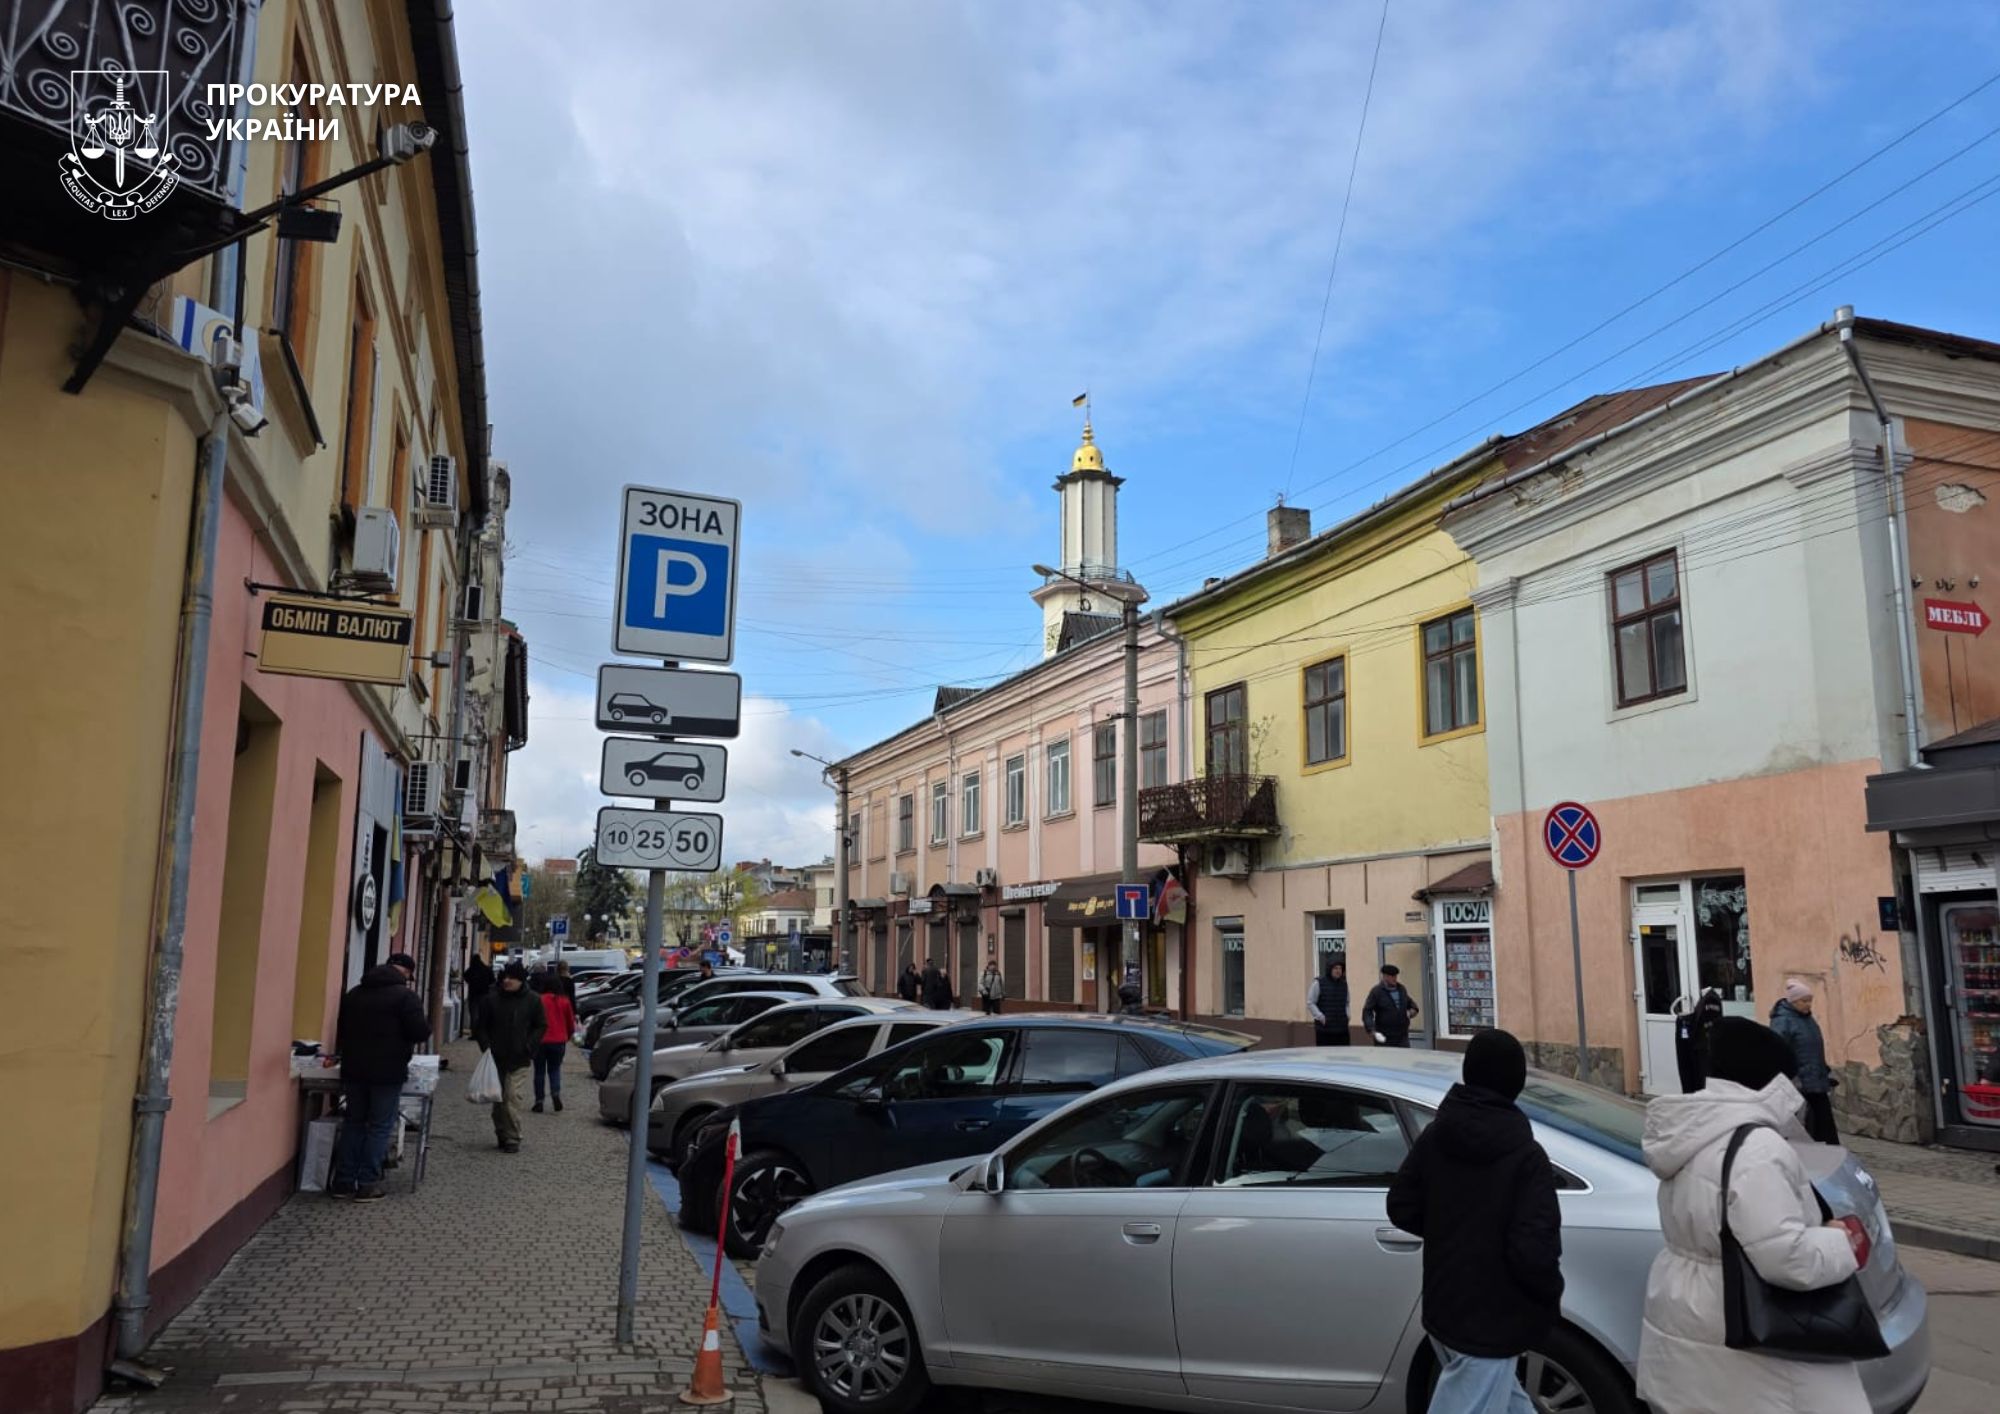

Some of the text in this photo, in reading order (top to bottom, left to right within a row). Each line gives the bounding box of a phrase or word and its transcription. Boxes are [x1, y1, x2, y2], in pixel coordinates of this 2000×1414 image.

[639, 501, 723, 535] ЗОНА
[653, 548, 707, 618] P
[271, 607, 402, 640] ОБМІН ВАЛЮТ
[1928, 606, 1982, 627] МЕБЛІ
[608, 830, 709, 853] 10 25 50
[1444, 902, 1489, 922] ПОСУД
